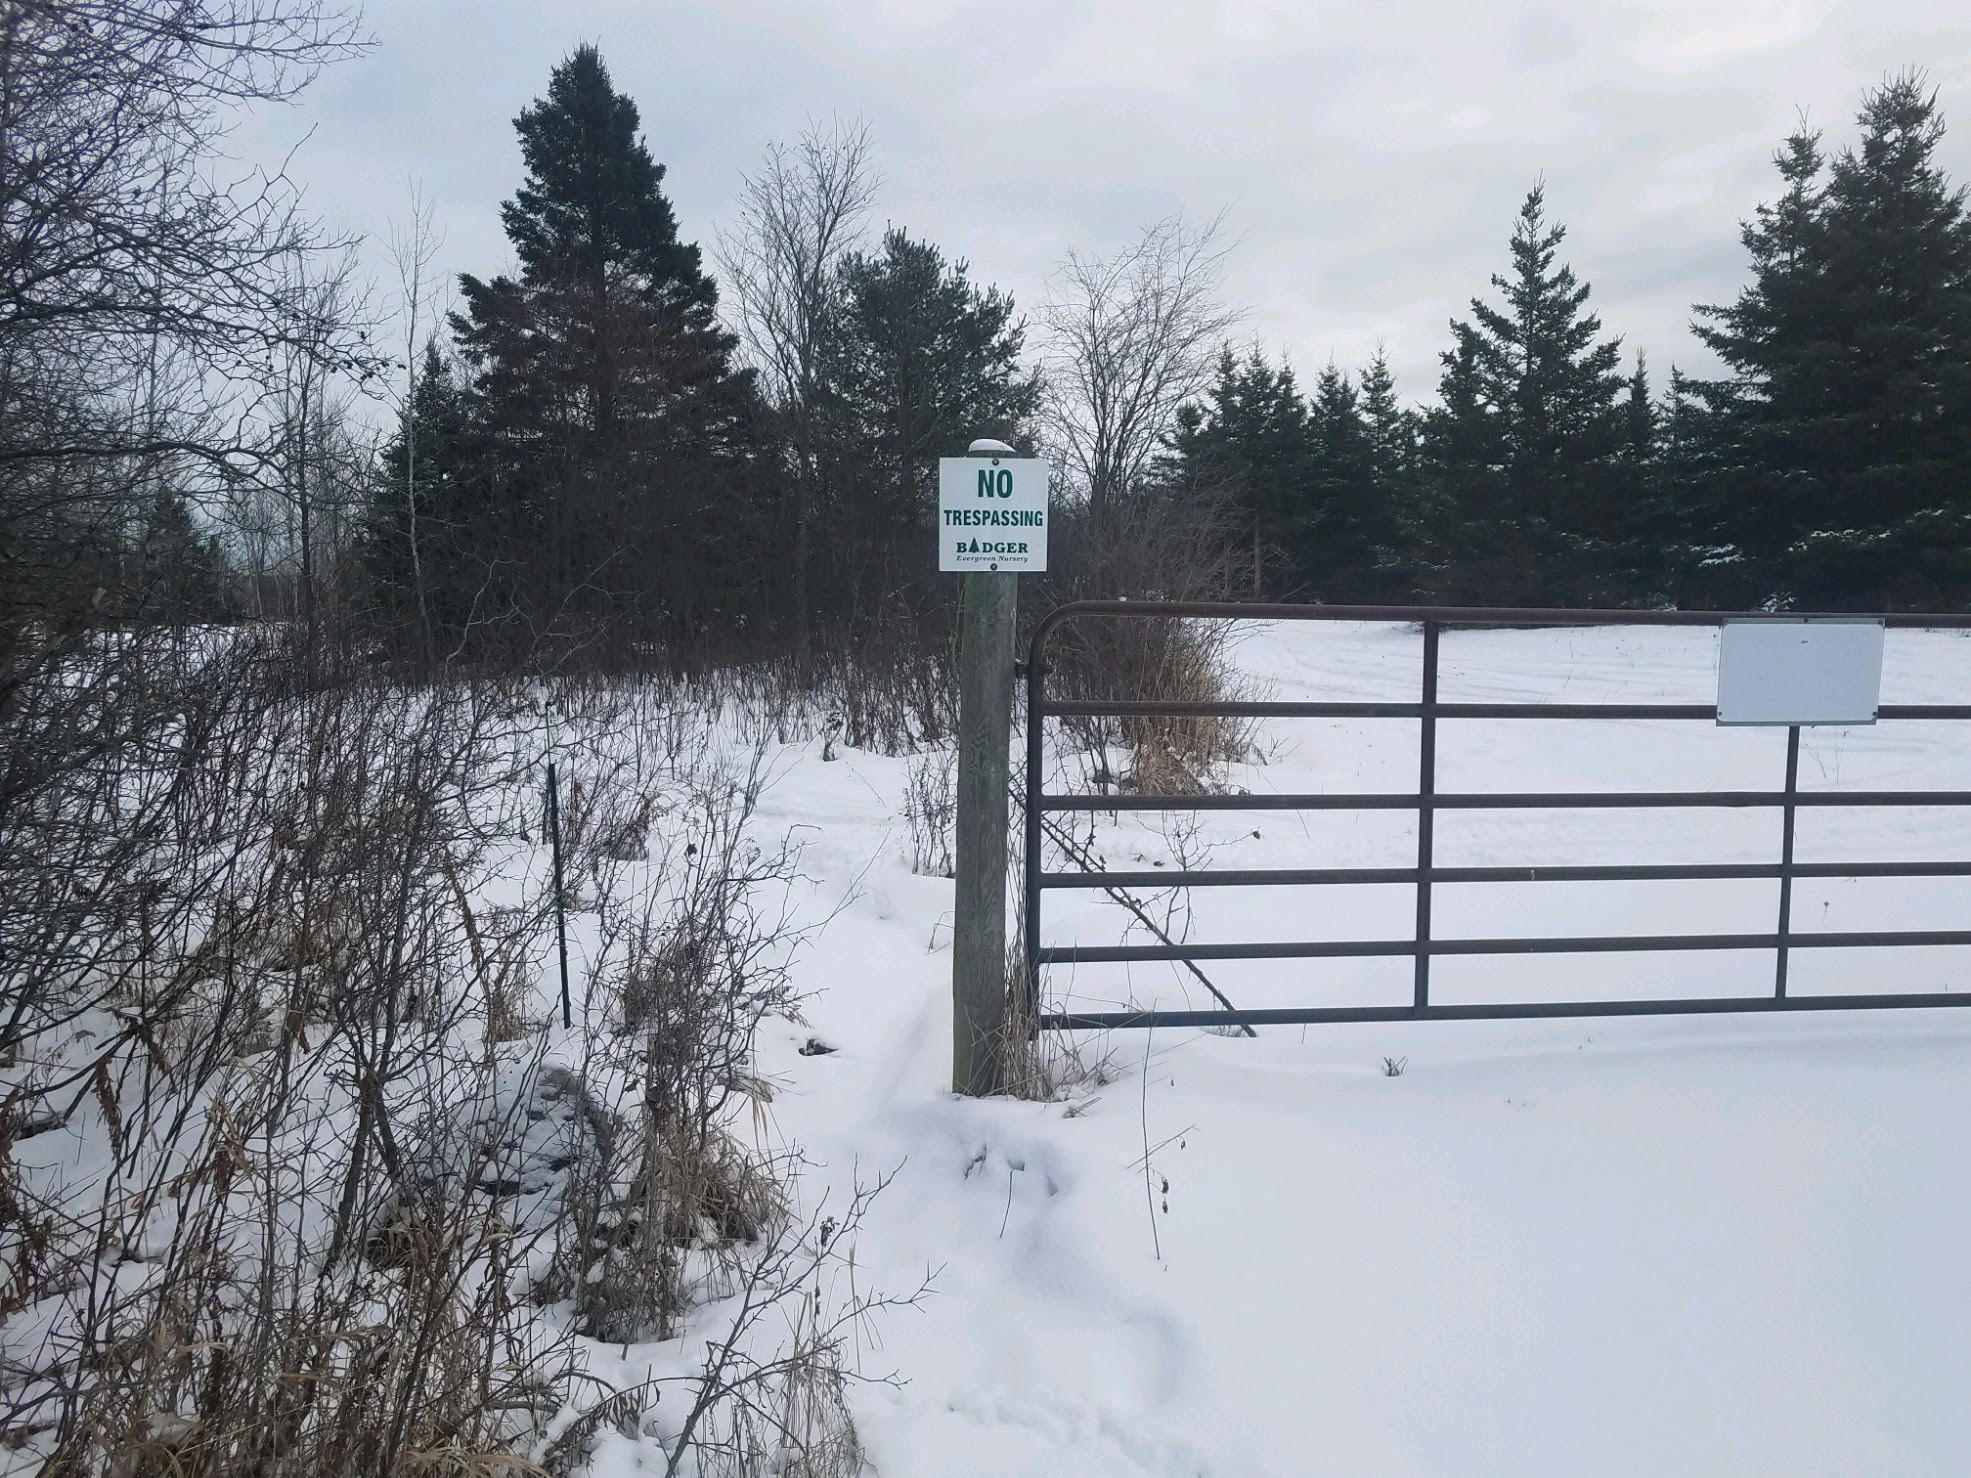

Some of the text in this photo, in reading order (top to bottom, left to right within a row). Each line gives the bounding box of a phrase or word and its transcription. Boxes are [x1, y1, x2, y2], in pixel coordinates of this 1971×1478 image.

[978, 469, 1013, 498] NO
[944, 509, 1043, 526] TRESPASSING
[956, 555, 1028, 563] Evergreen Nursery
